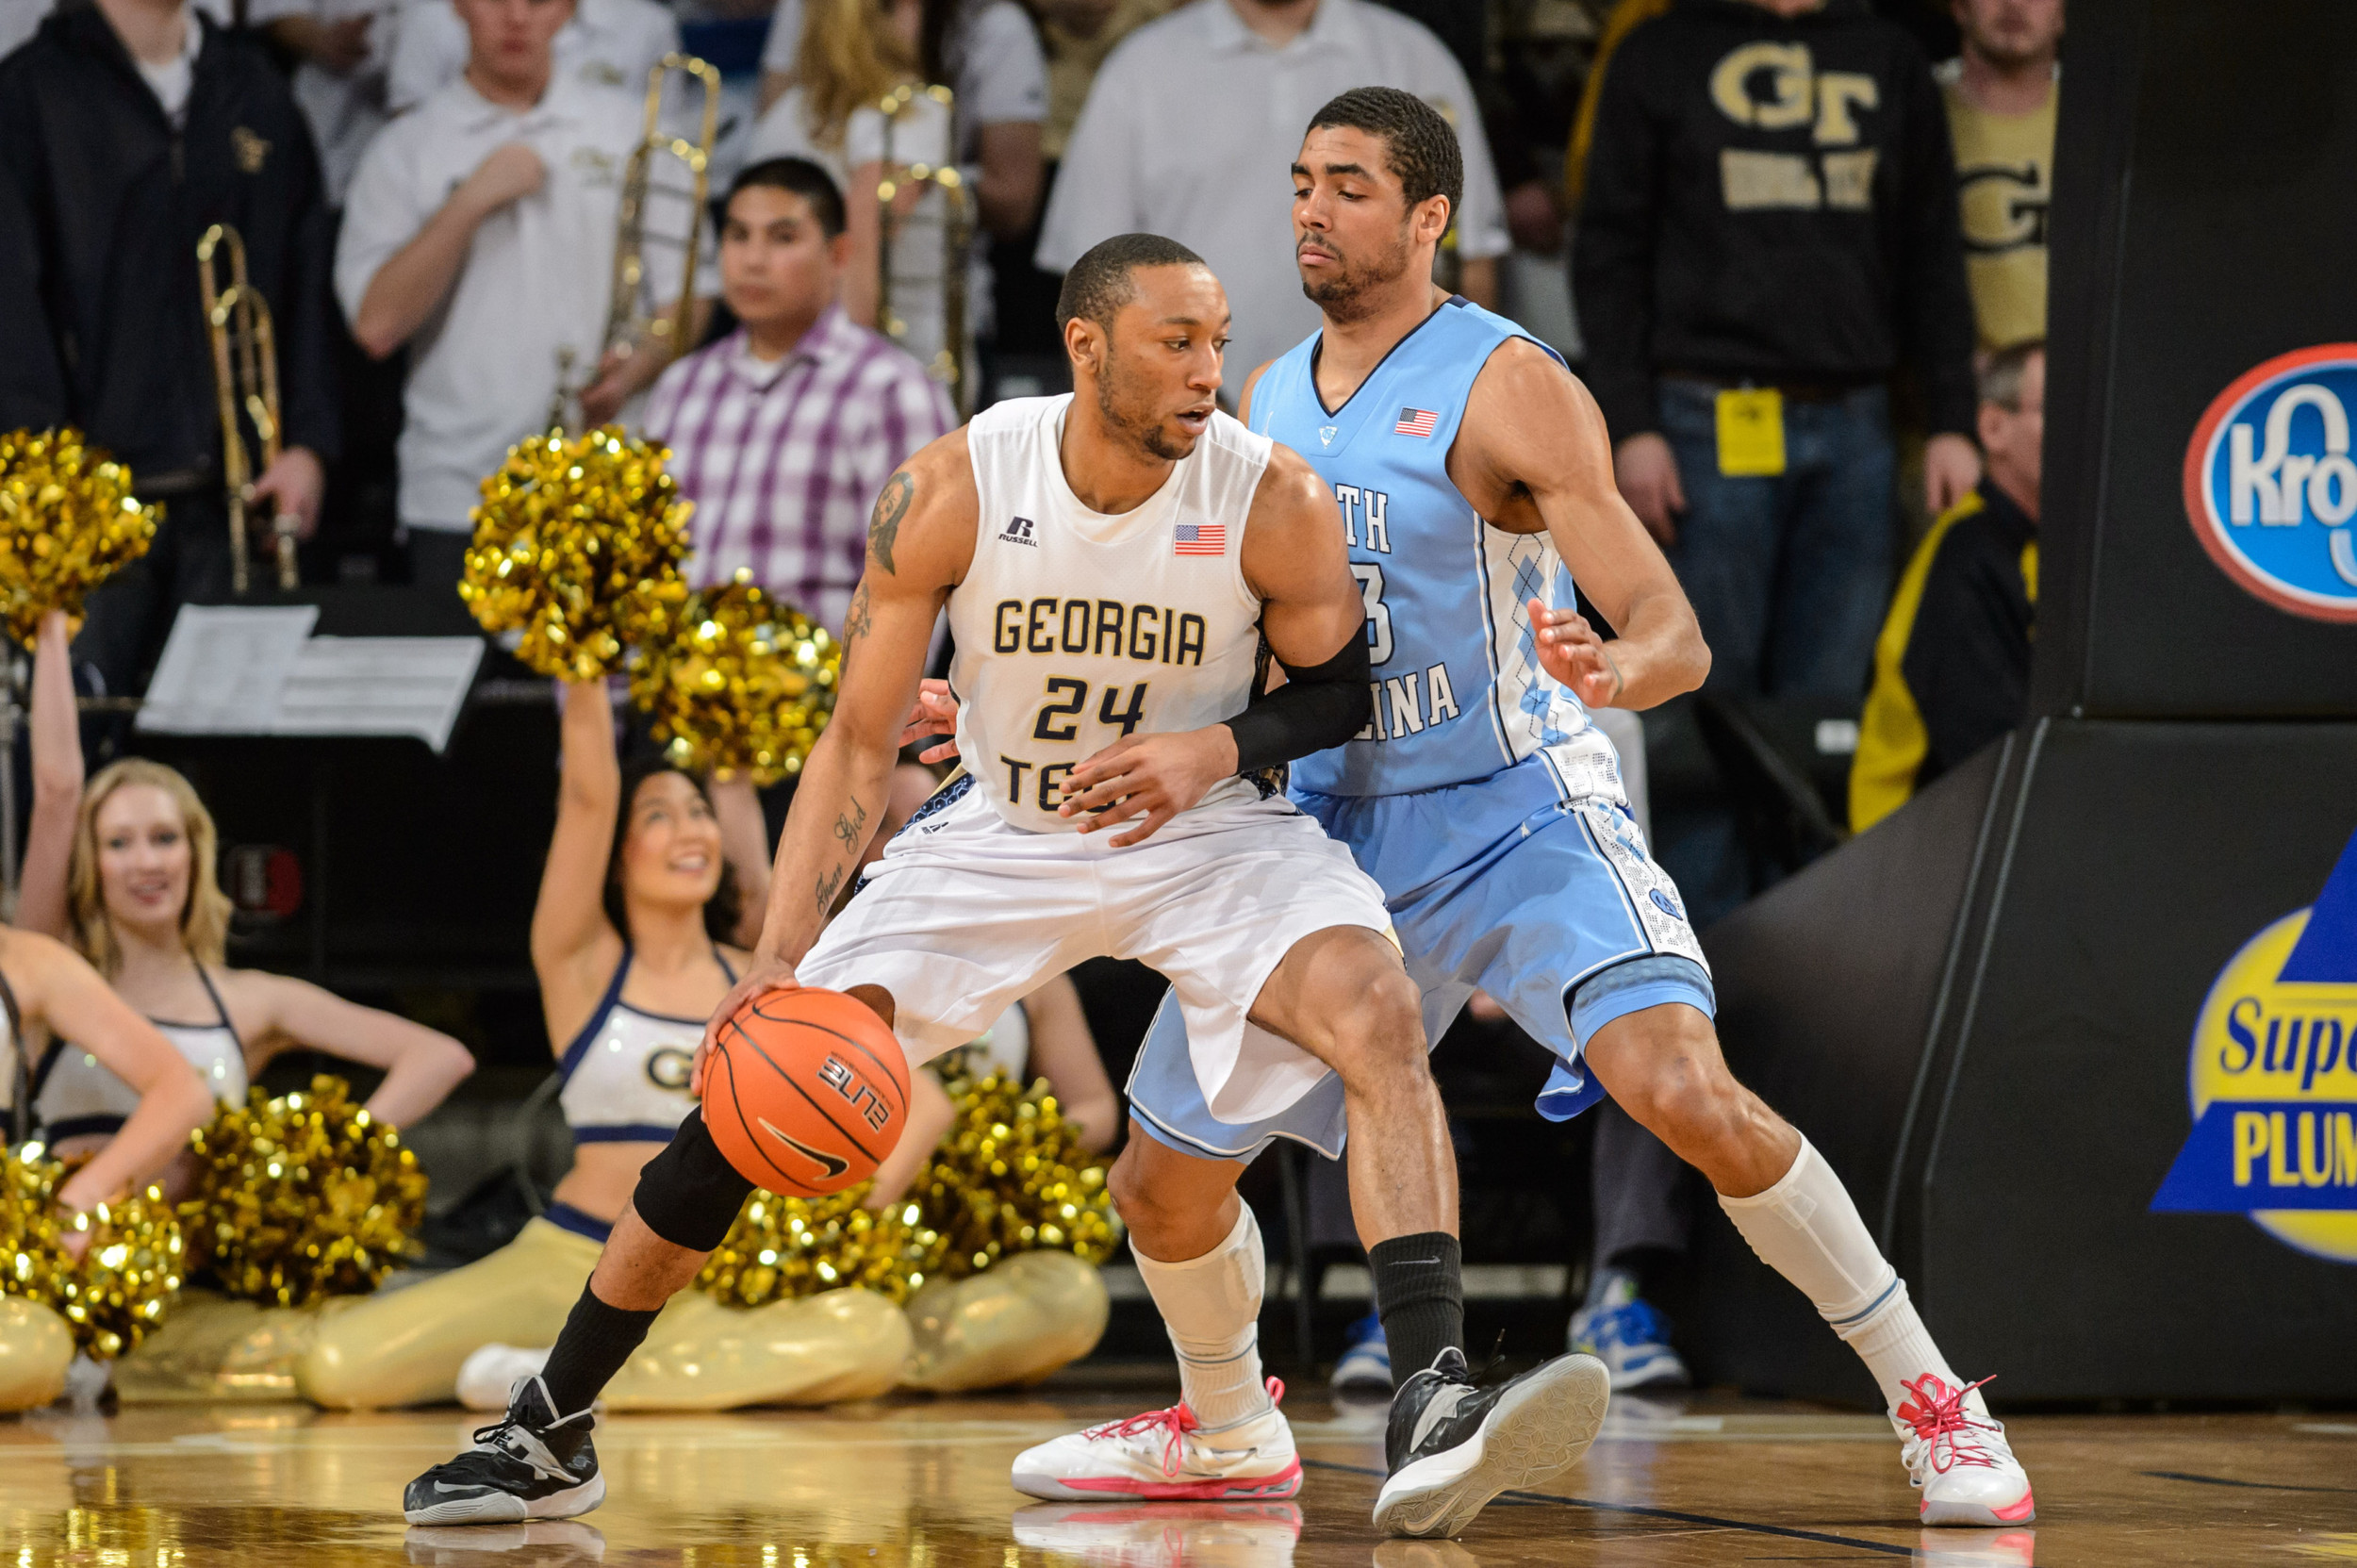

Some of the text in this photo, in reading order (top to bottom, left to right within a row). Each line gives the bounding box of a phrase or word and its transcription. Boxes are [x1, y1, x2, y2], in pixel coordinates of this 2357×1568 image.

[1709, 41, 1882, 146] GT
[2230, 383, 2357, 587] Kro
[998, 533, 1038, 548] RUSSELL
[994, 596, 1208, 668] GEORGIA
[1030, 674, 1151, 744] 24
[2220, 997, 2357, 1093] Sup
[816, 1055, 891, 1133] ELITE
